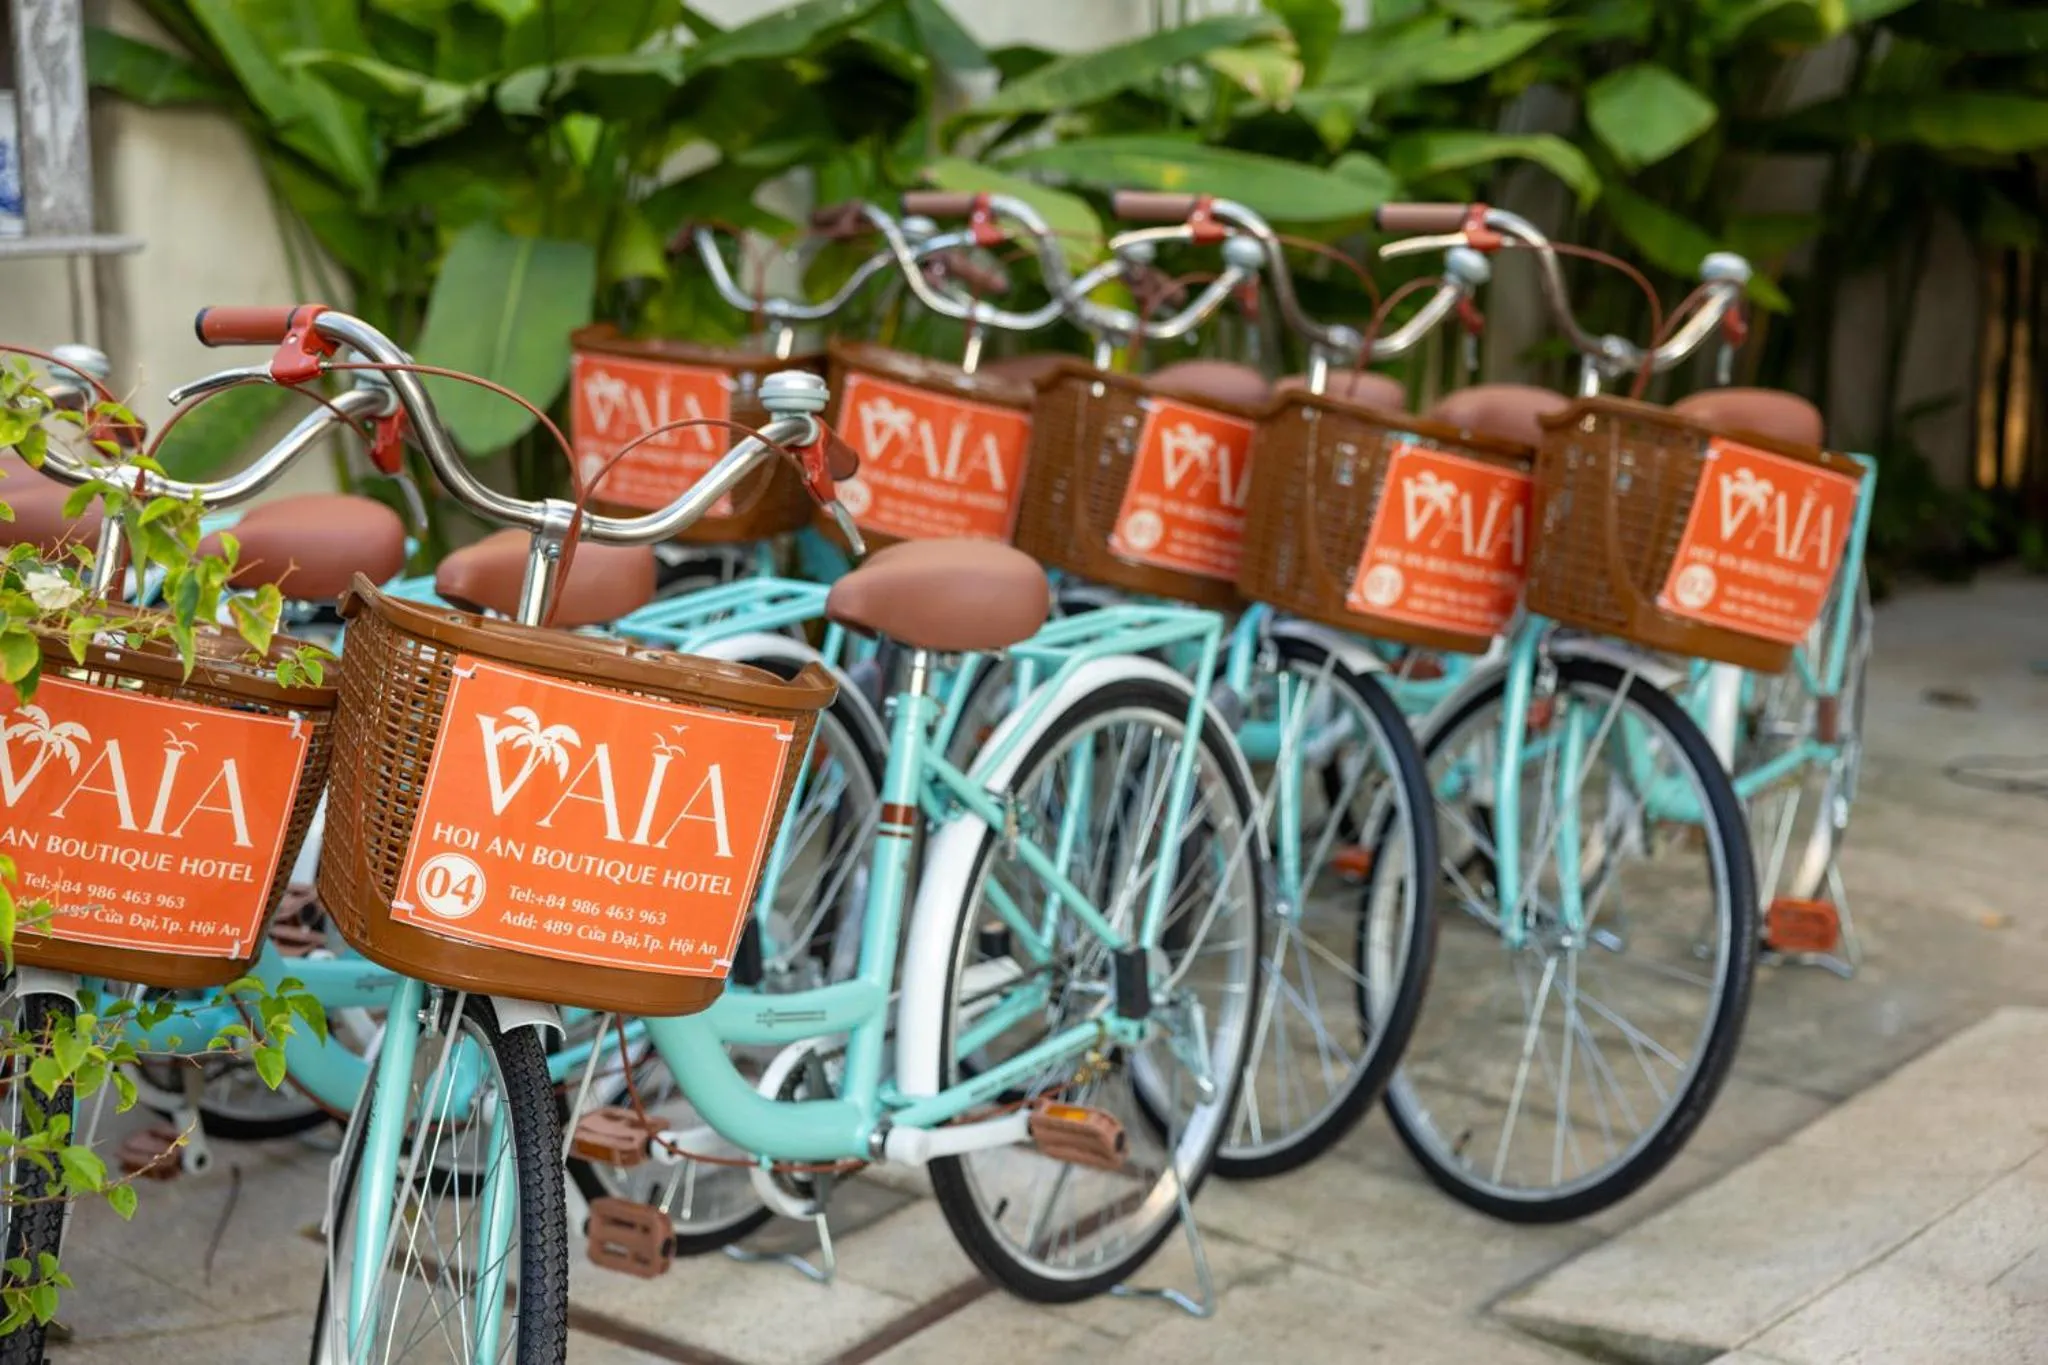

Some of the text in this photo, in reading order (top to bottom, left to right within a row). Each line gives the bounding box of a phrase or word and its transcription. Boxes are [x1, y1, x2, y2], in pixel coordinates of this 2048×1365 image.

[1402, 469, 1525, 566] VAIA
[1718, 466, 1834, 569] VAIA
[0, 704, 254, 848] VAIA
[475, 705, 734, 858] VAIA
[0, 826, 255, 883] AN BOUTIQUE HOTEL
[432, 821, 733, 896] HOI AN BOUTIQUE HOTEL
[87, 883, 117, 901] 986
[121, 888, 153, 906] 463
[156, 894, 186, 910] 963
[425, 866, 477, 907] 04
[571, 898, 601, 916] 986
[605, 904, 635, 921] 463
[639, 910, 668, 926] 963
[219, 922, 241, 937] An
[499, 910, 537, 930] Add:
[542, 918, 573, 936] 489
[697, 941, 718, 956] An
